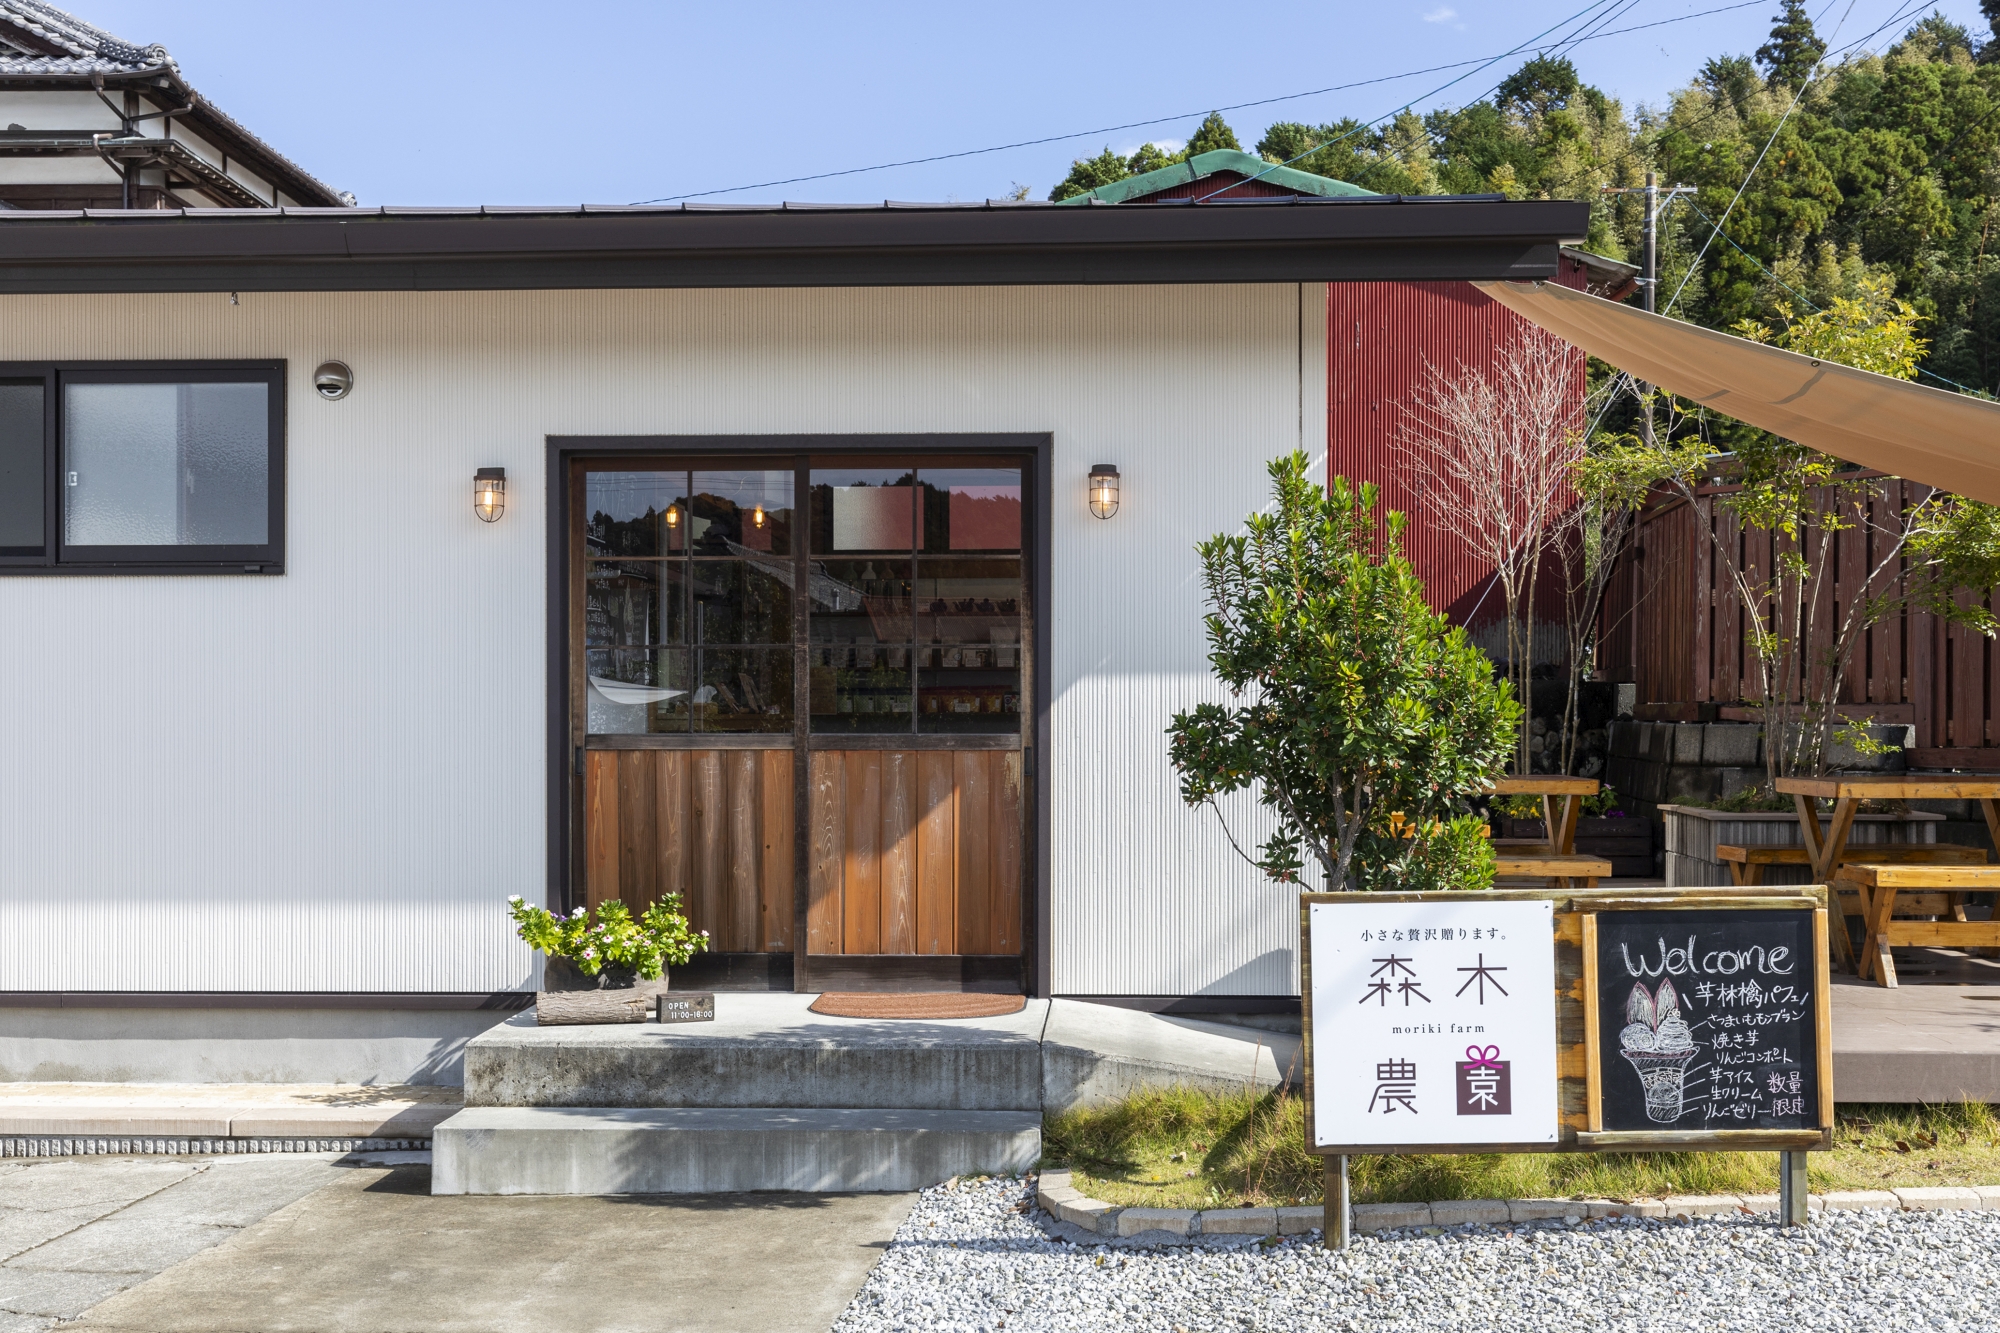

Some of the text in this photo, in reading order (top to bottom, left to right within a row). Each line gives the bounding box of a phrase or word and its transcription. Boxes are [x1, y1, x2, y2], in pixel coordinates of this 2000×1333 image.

[1361, 927, 1506, 942] 小さな贅沢贈ります。
[1621, 935, 1795, 977] Welcome
[1695, 979, 1800, 1009] 芋林檎パフェ
[668, 1001, 689, 1010] OPEN
[1707, 1008, 1806, 1029] さつまいもモンブラン
[1392, 1023, 1485, 1034] moriki farm
[1711, 1029, 1760, 1049] 焼き芋
[1716, 1047, 1793, 1065] りんごコンポート
[1709, 1066, 1754, 1084] 芋アイス
[1766, 1071, 1803, 1094] 数量
[1711, 1084, 1763, 1101] 生クリーム
[1702, 1102, 1772, 1120] りんごゼリー
[1772, 1095, 1808, 1117] 限定
